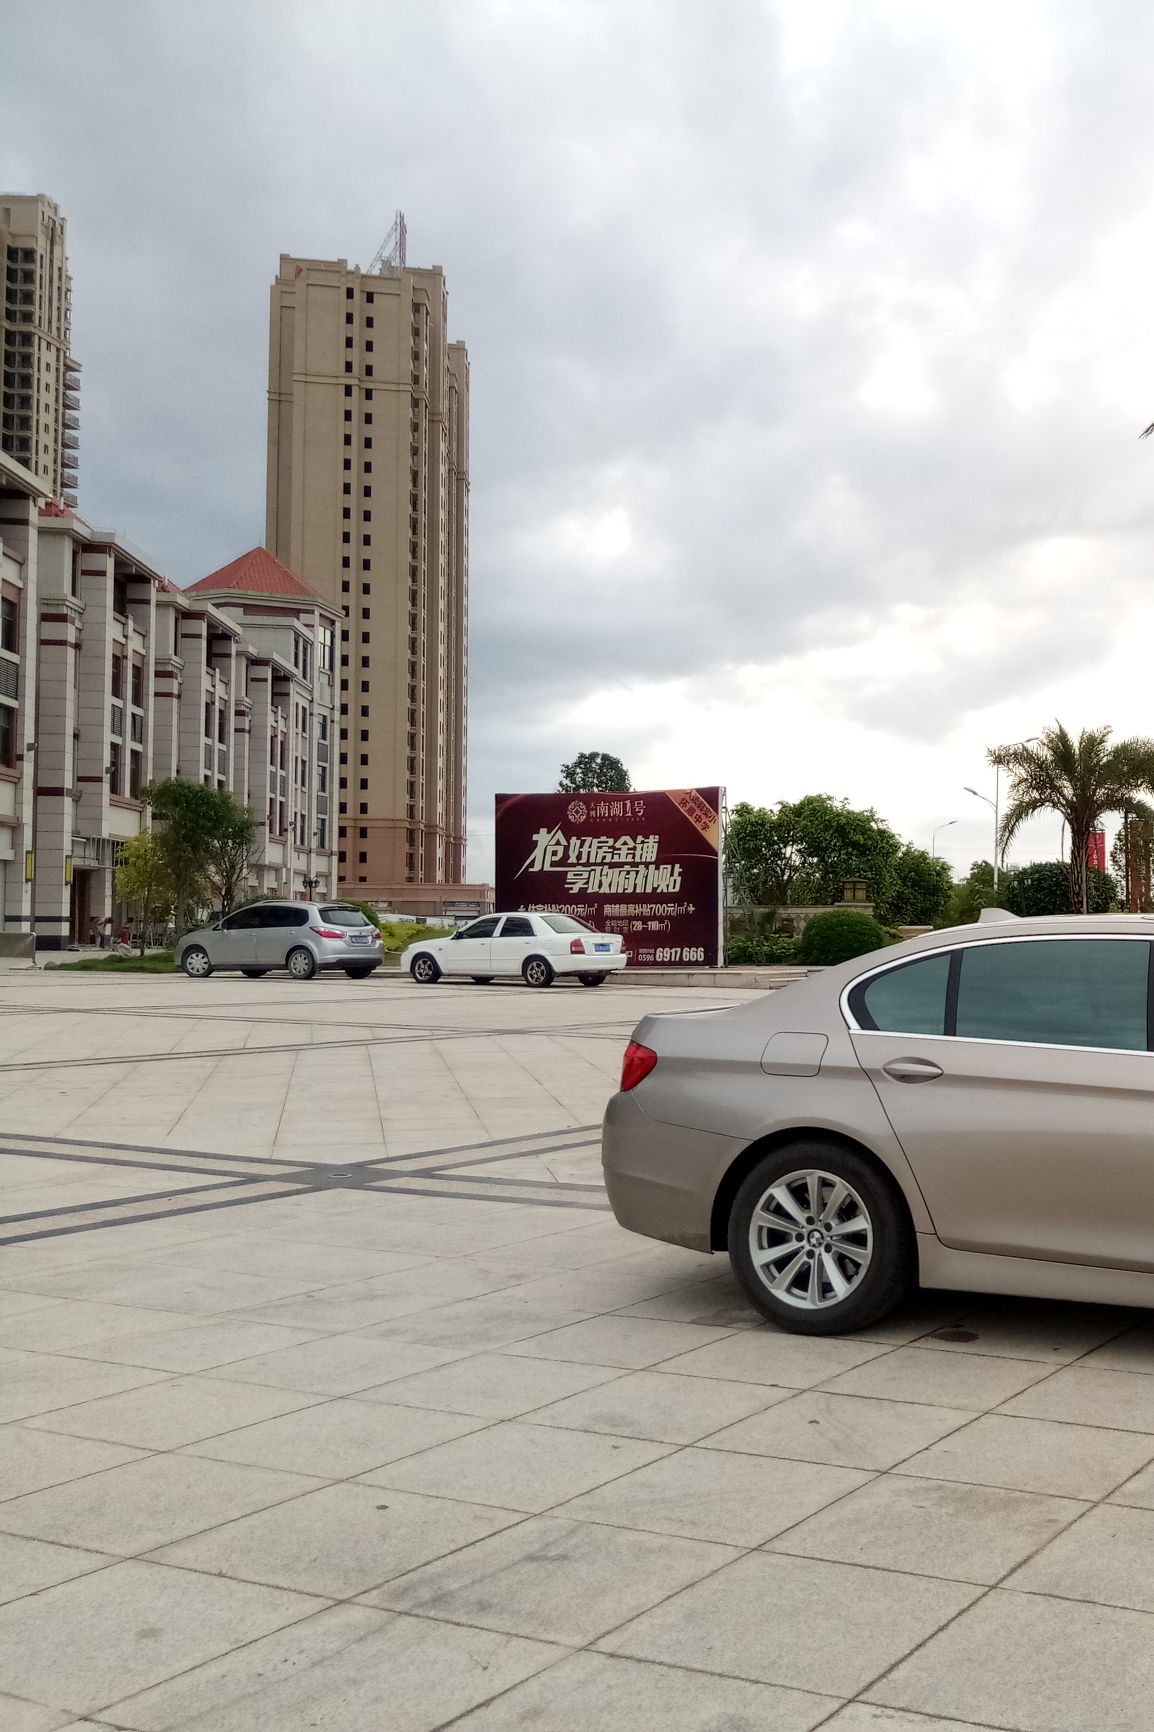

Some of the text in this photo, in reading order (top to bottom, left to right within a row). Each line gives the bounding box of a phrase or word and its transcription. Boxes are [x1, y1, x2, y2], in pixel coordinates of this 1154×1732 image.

[565, 864, 682, 894] 享政府补贴
[638, 954, 655, 962] 0596
